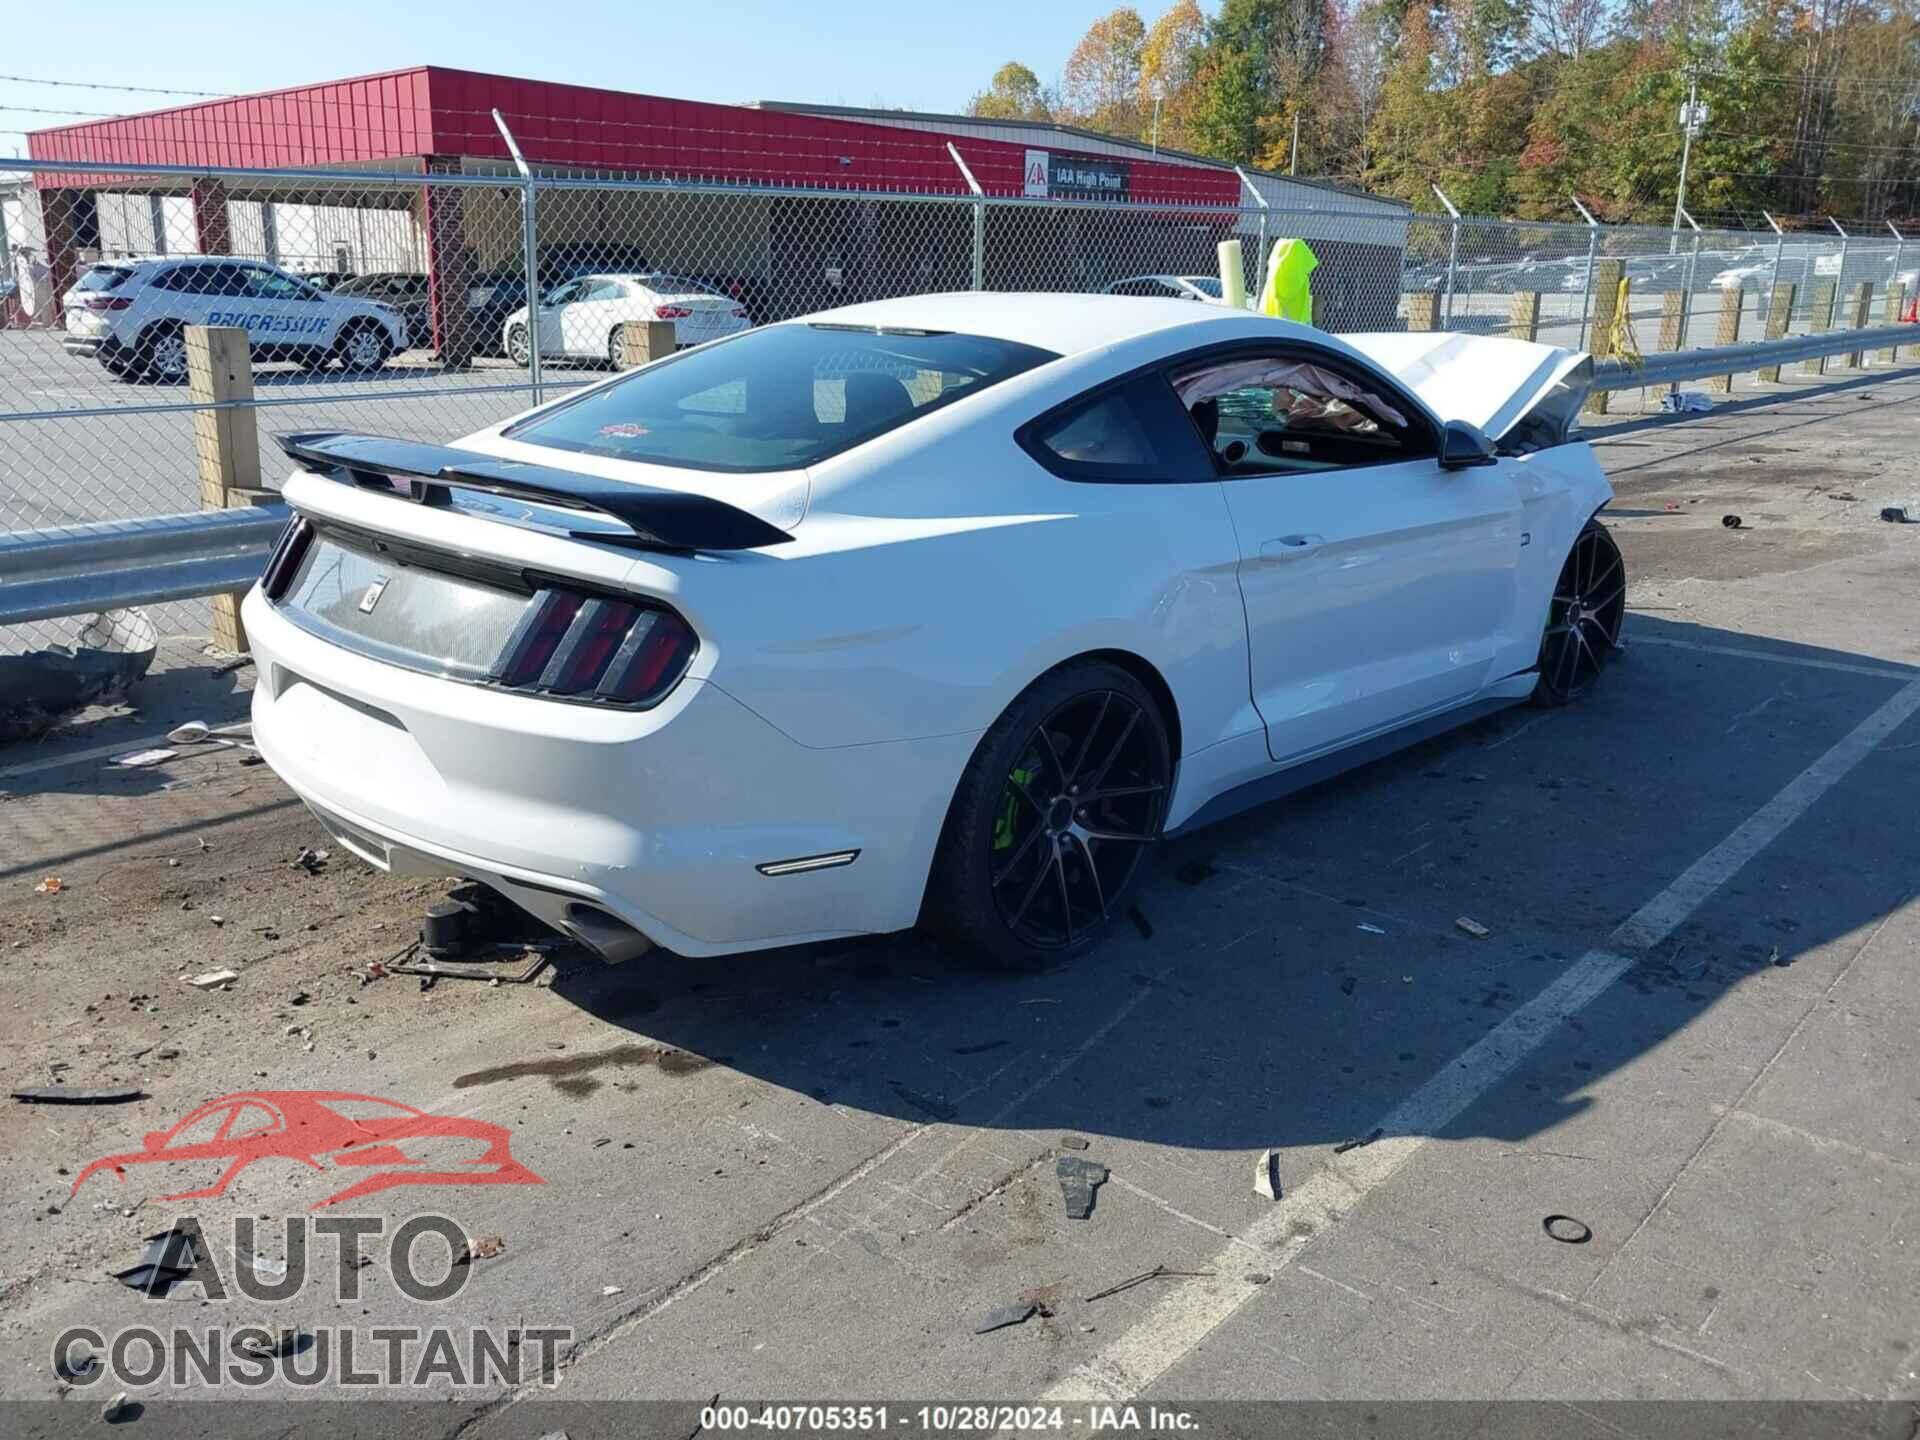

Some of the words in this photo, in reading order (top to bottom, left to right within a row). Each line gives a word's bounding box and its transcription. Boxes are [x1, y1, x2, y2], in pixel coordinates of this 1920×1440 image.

[1057, 167, 1075, 184] IAA
[1076, 169, 1098, 188] High
[1099, 172, 1121, 188] Point
